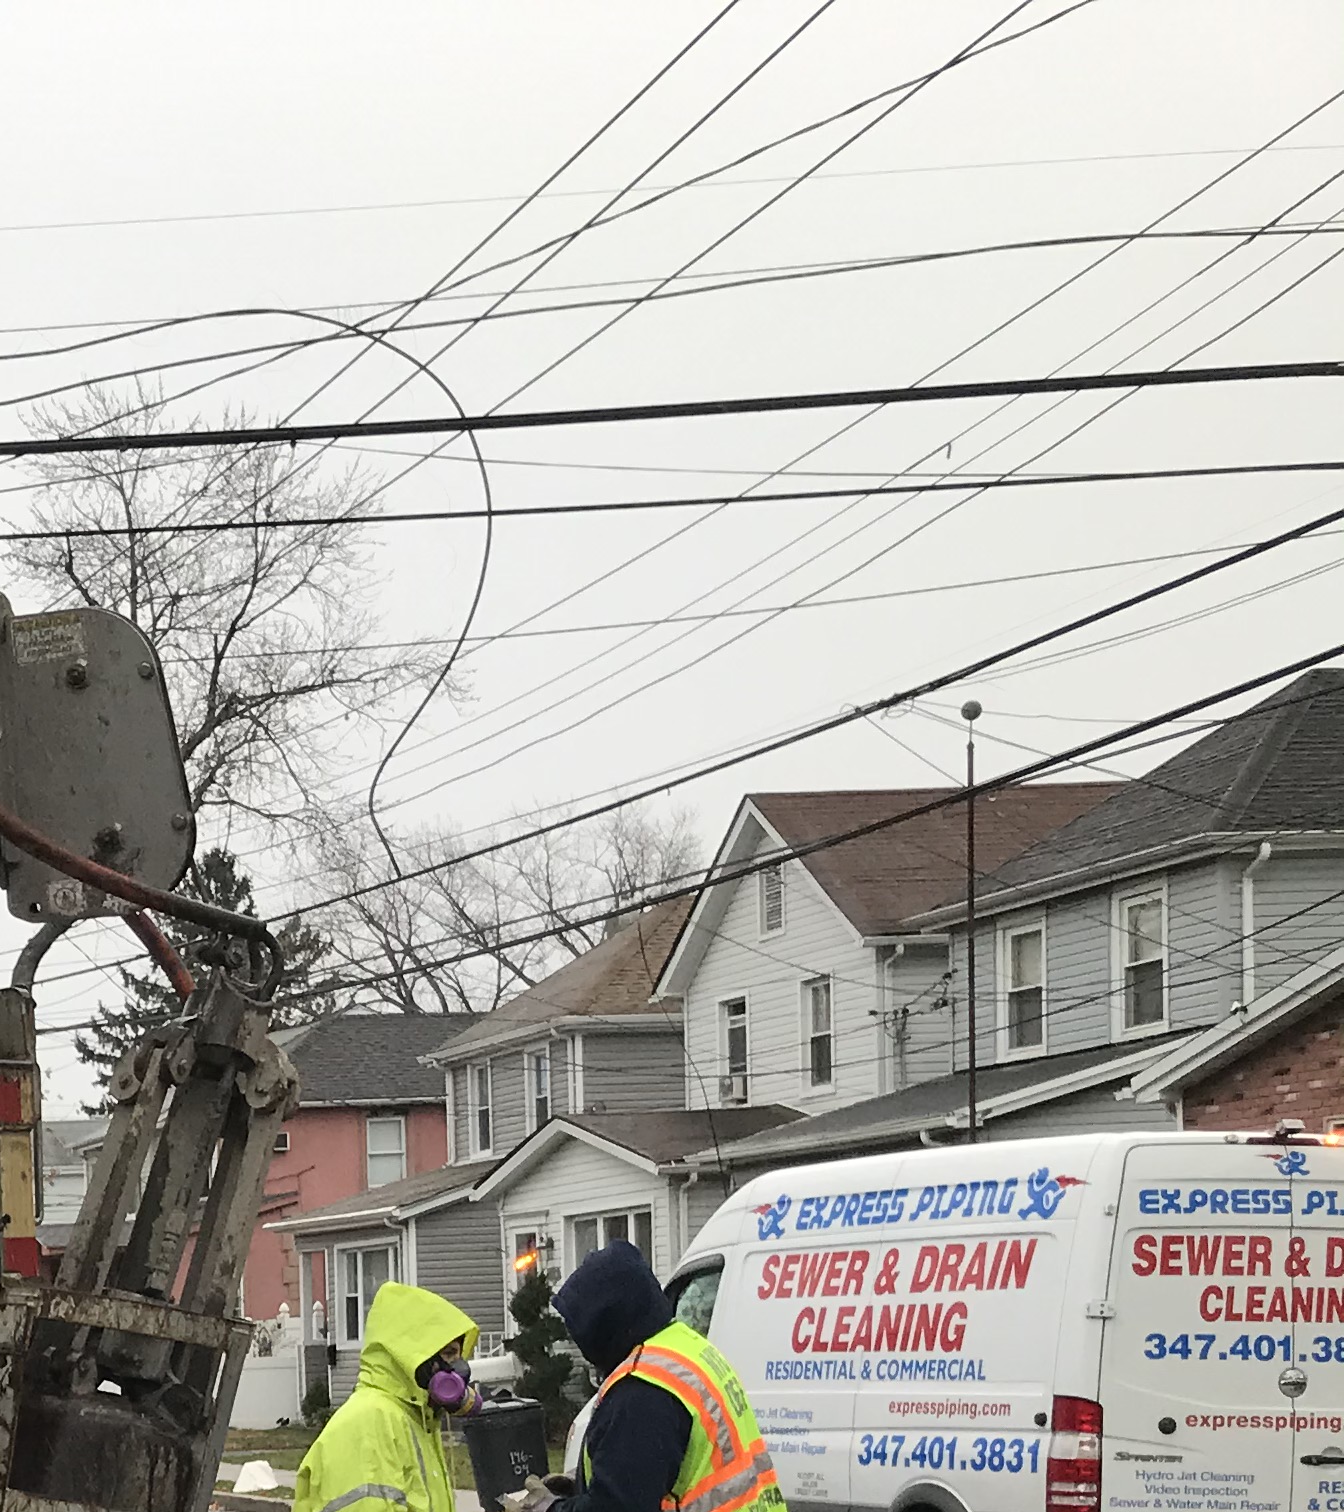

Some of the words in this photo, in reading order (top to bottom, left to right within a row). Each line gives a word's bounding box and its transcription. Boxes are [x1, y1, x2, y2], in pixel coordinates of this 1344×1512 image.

[796, 1188, 910, 1230] EXPRESS
[909, 1177, 1018, 1222] PIPING
[1139, 1189, 1292, 1214] EXPRESS
[1132, 1234, 1273, 1277] SEWER
[1284, 1236, 1311, 1278] &
[757, 1250, 869, 1300] SEWER
[873, 1248, 900, 1296] &
[910, 1238, 1038, 1294] DRAIN
[791, 1301, 968, 1353] CLEANING
[765, 1360, 856, 1380] RESIDENTIAL
[861, 1360, 871, 1379] &
[876, 1359, 986, 1381] COMMERCIAL
[888, 1398, 1011, 1419] expresspiping.com
[858, 1433, 1041, 1473] 347.401.3831
[1135, 1470, 1173, 1482] Hydro
[1177, 1471, 1196, 1481] Jet
[1201, 1471, 1255, 1485] Cleaning
[1144, 1485, 1180, 1495] Video
[1184, 1485, 1248, 1498] Inspection
[1109, 1497, 1151, 1509] Sewer
[1167, 1499, 1203, 1510] Water
[1207, 1500, 1237, 1511] Main
[1240, 1501, 1281, 1512] Repair
